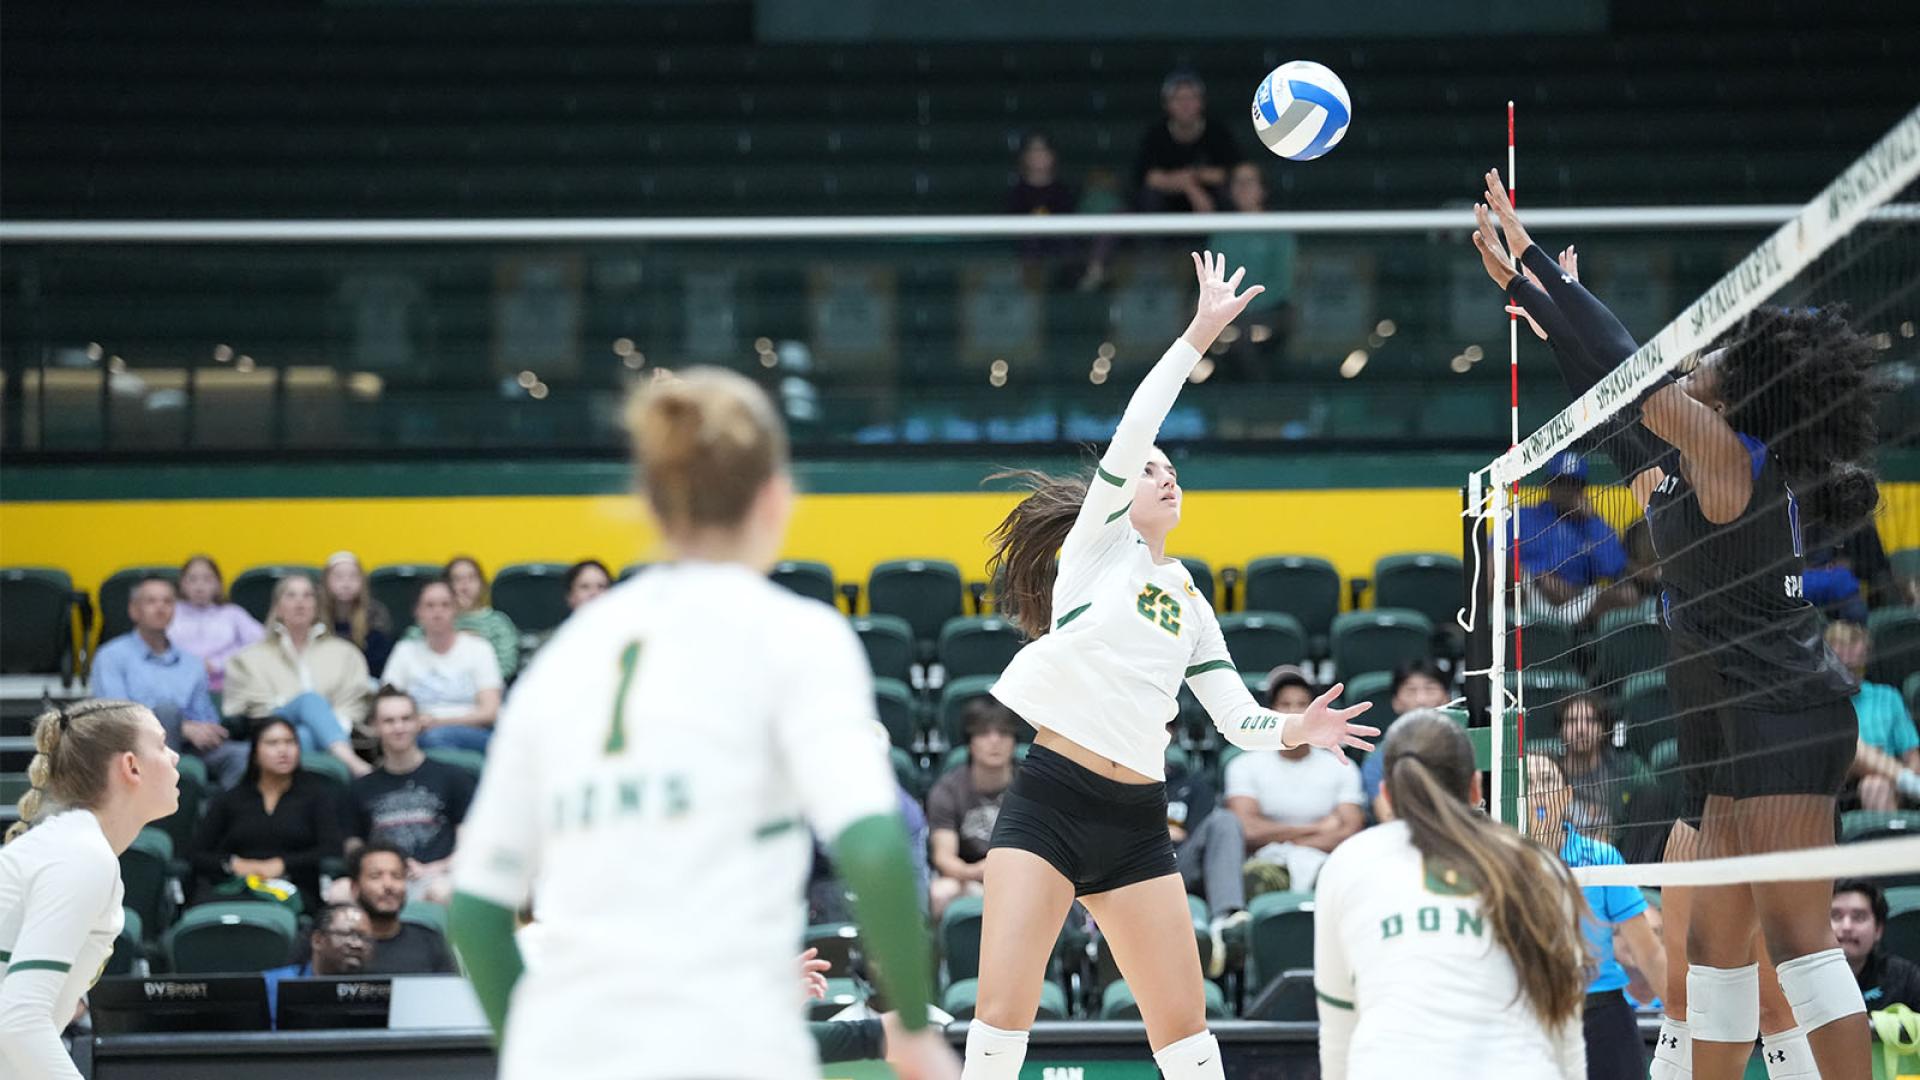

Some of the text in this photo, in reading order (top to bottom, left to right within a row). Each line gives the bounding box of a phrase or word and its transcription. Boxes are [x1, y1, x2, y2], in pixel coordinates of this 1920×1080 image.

[1136, 581, 1183, 640] 22
[602, 638, 643, 759] 1
[1240, 714, 1279, 731] DONS
[1381, 905, 1484, 940] DON
